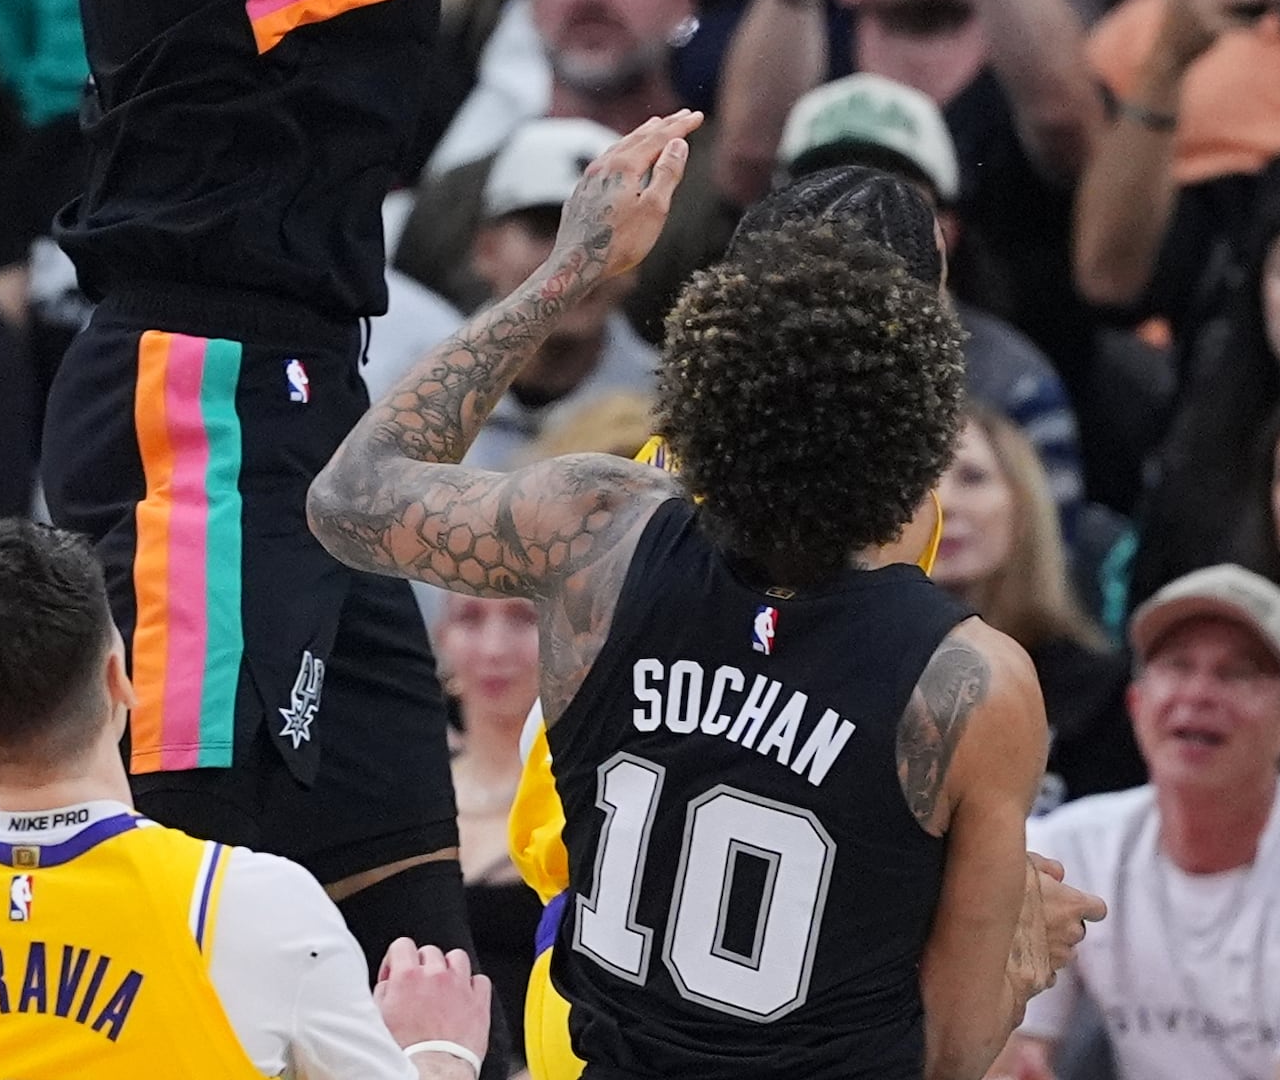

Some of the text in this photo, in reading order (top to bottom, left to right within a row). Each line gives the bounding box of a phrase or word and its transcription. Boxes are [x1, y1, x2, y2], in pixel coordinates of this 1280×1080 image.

[633, 658, 857, 787] SOCHAN
[8, 808, 90, 832] NIKE PRO
[572, 750, 838, 1025] 10
